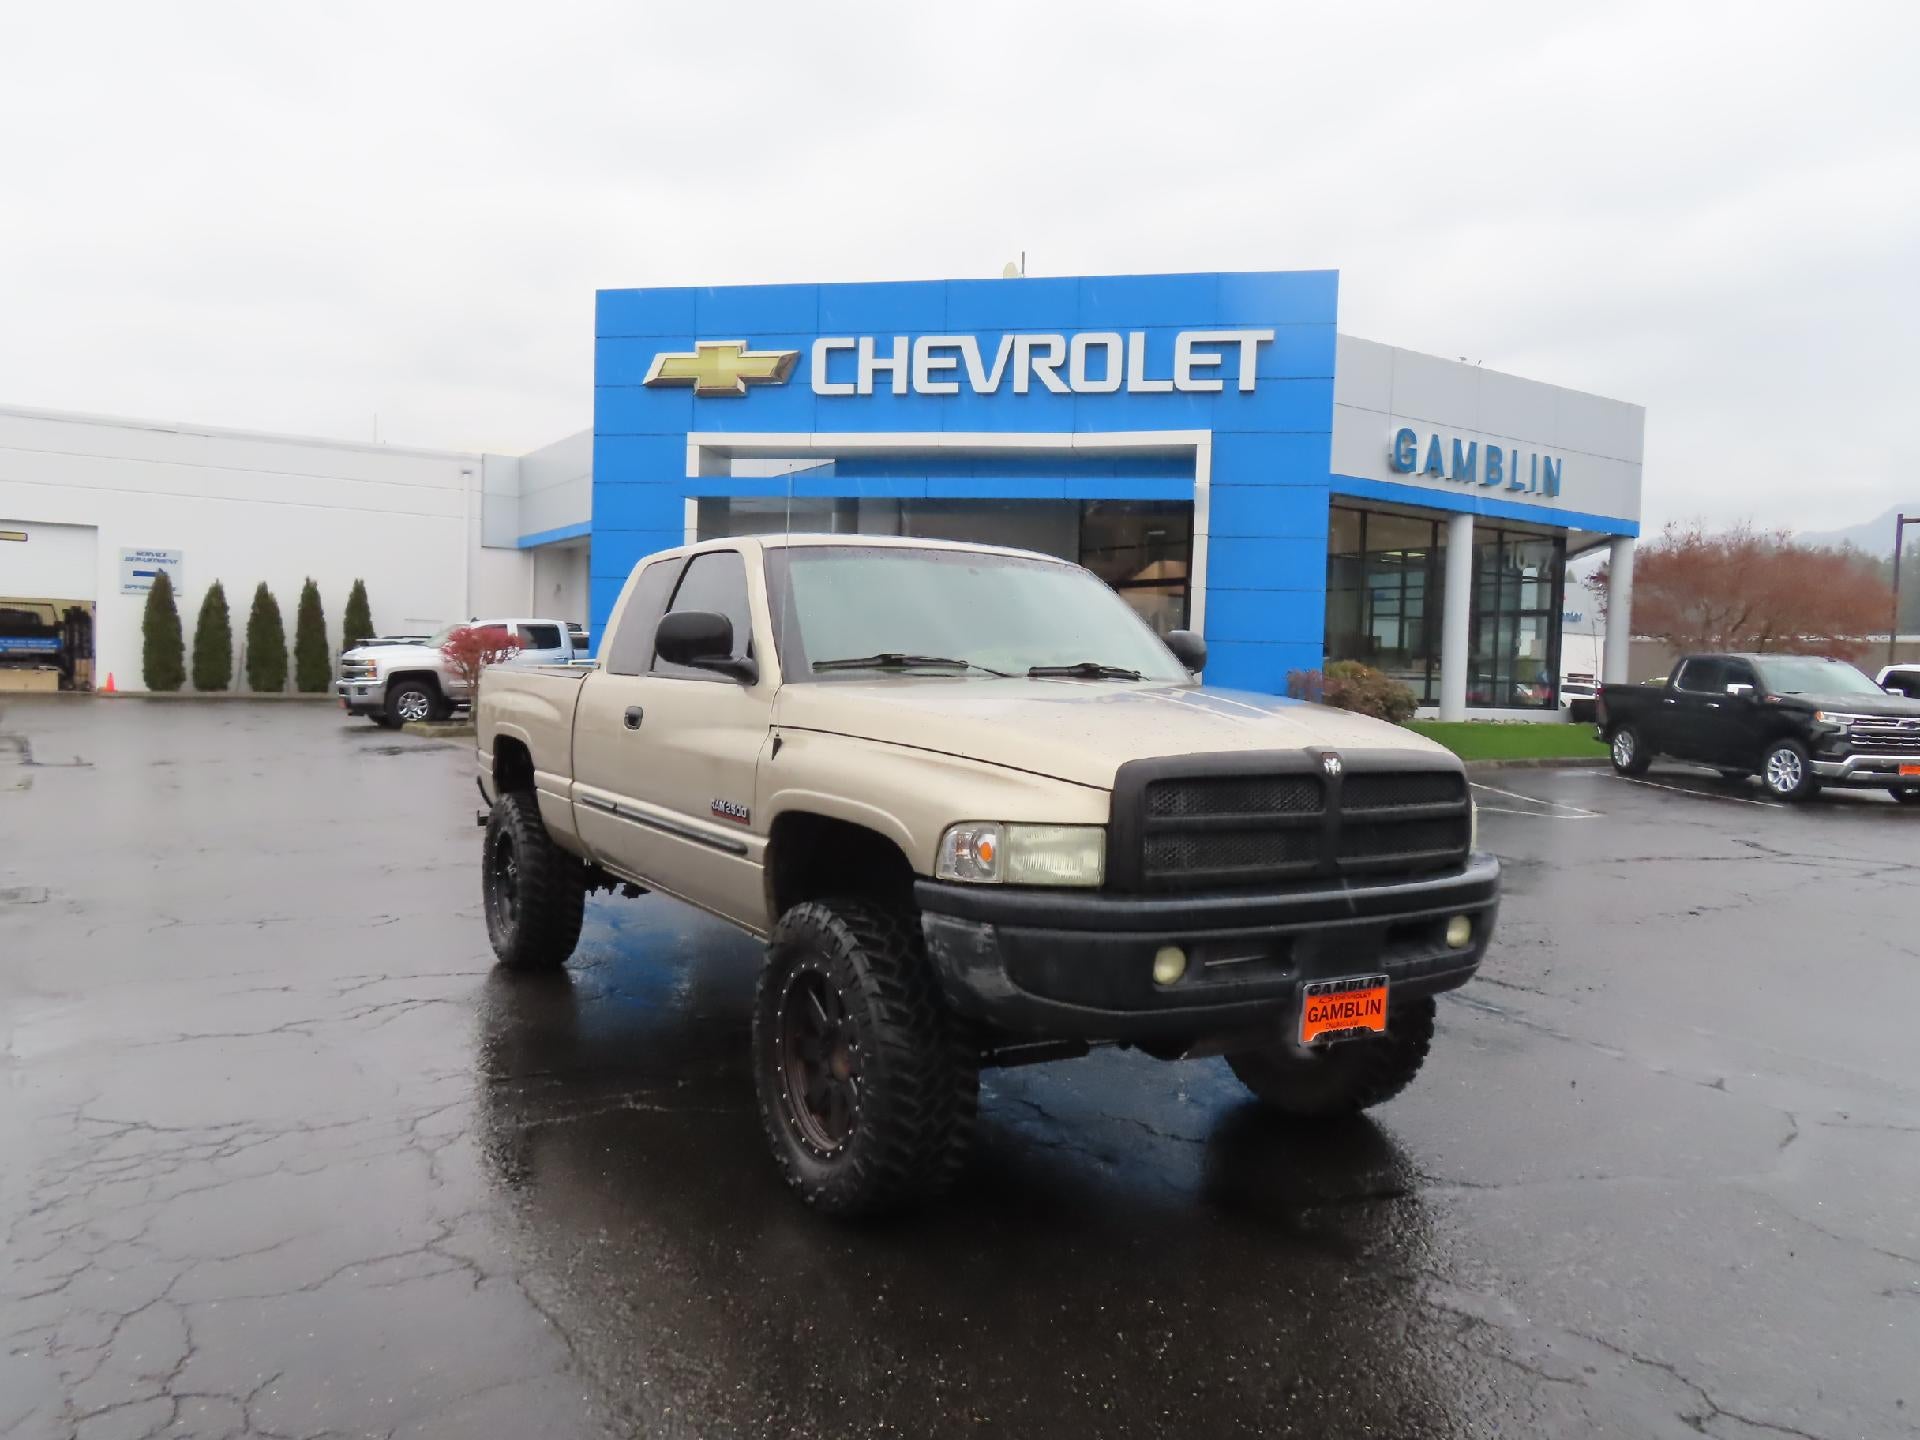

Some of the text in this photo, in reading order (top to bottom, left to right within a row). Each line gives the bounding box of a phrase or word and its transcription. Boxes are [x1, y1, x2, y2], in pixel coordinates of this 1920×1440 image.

[811, 329, 1275, 395] CHEVROLET
[1390, 428, 1562, 497] GAMBLIN
[124, 556, 178, 565] DEPARTMENT
[725, 802, 747, 818] 2500
[1307, 999, 1382, 1023] GAMBLIN
